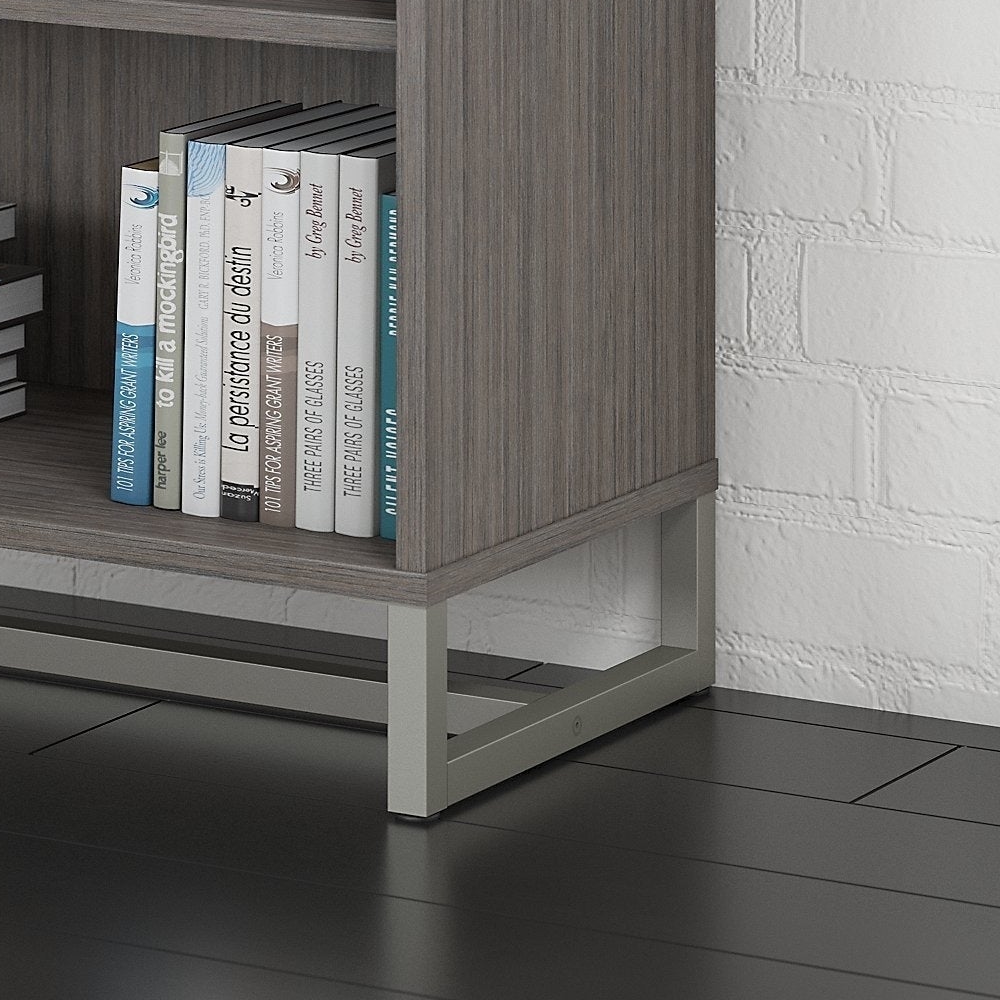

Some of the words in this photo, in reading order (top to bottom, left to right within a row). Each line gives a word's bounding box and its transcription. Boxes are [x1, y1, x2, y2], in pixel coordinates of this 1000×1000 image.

[306, 183, 323, 218] Bennet
[345, 187, 363, 222] Bennet
[124, 224, 143, 252] Robbins
[267, 211, 284, 242] Robbins
[305, 220, 327, 244] Greg
[345, 224, 367, 248] Greg
[267, 246, 284, 281] Veronica
[305, 247, 326, 260] by
[345, 250, 366, 264] by
[124, 254, 142, 285] Veronica
[157, 212, 184, 334] mockingbird
[223, 246, 252, 297] destin
[198, 290, 209, 310] GARY
[223, 302, 251, 325] du
[121, 332, 139, 368] WRITERS
[159, 339, 176, 353] a
[266, 334, 283, 373] WRITERS
[120, 368, 138, 400] GRANT
[155, 357, 174, 383] kill
[222, 330, 258, 429] persistance
[305, 360, 323, 407] GLASSES
[156, 389, 175, 408] to
[265, 374, 282, 409] GRANT
[345, 365, 363, 412] GLASSES
[118, 400, 137, 440] ASPIRING
[305, 409, 323, 424] OF
[345, 414, 362, 429] OF
[155, 430, 167, 449] lee
[221, 433, 249, 452] La
[265, 410, 282, 455] ASPIRING
[304, 427, 322, 457] PAIRS
[344, 432, 362, 462] PAIRS
[118, 439, 135, 458] FOR
[117, 458, 135, 474] TIPS
[155, 451, 171, 490] harper
[264, 454, 282, 475] FOR
[303, 459, 321, 492] THREE
[117, 475, 134, 491] 101
[264, 475, 282, 493] TIPS
[343, 464, 362, 497] THREE
[264, 496, 281, 513] 101
